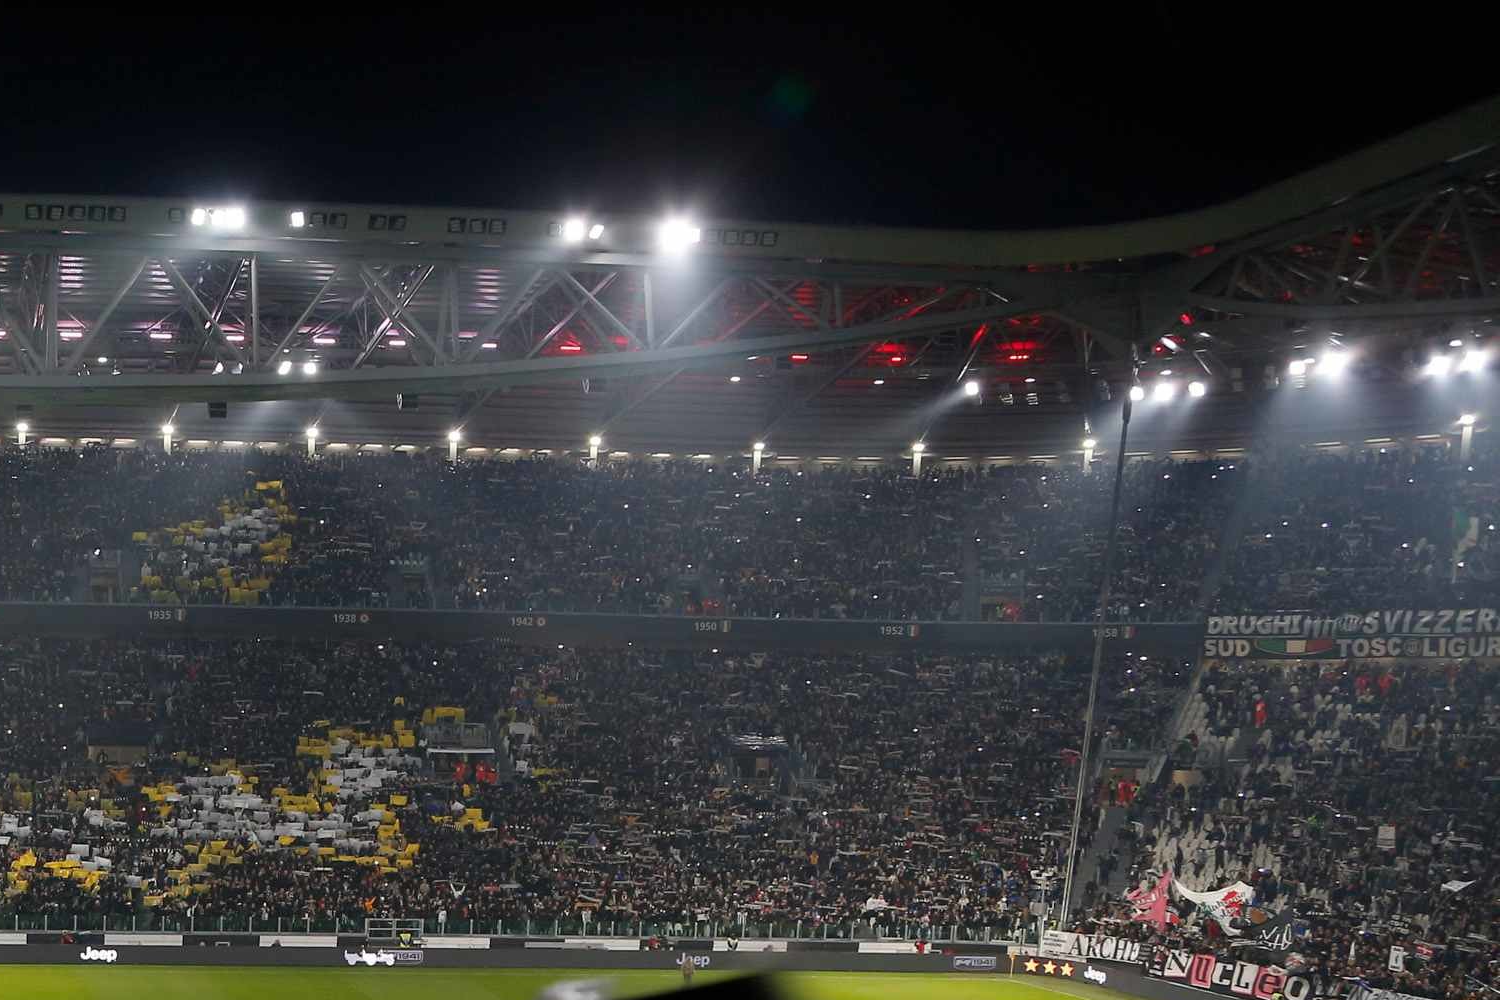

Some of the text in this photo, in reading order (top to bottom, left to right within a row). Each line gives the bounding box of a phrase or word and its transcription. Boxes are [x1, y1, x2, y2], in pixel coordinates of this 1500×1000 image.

[148, 610, 172, 620] 1935
[333, 614, 356, 623] 1938
[510, 617, 533, 626] 1942
[694, 622, 717, 631] 1950
[1207, 614, 1302, 634] DRUGHI
[880, 626, 904, 635] 1952
[1092, 628, 1118, 638] 158
[1204, 639, 1251, 657] SUD
[80, 945, 118, 963] Jeep
